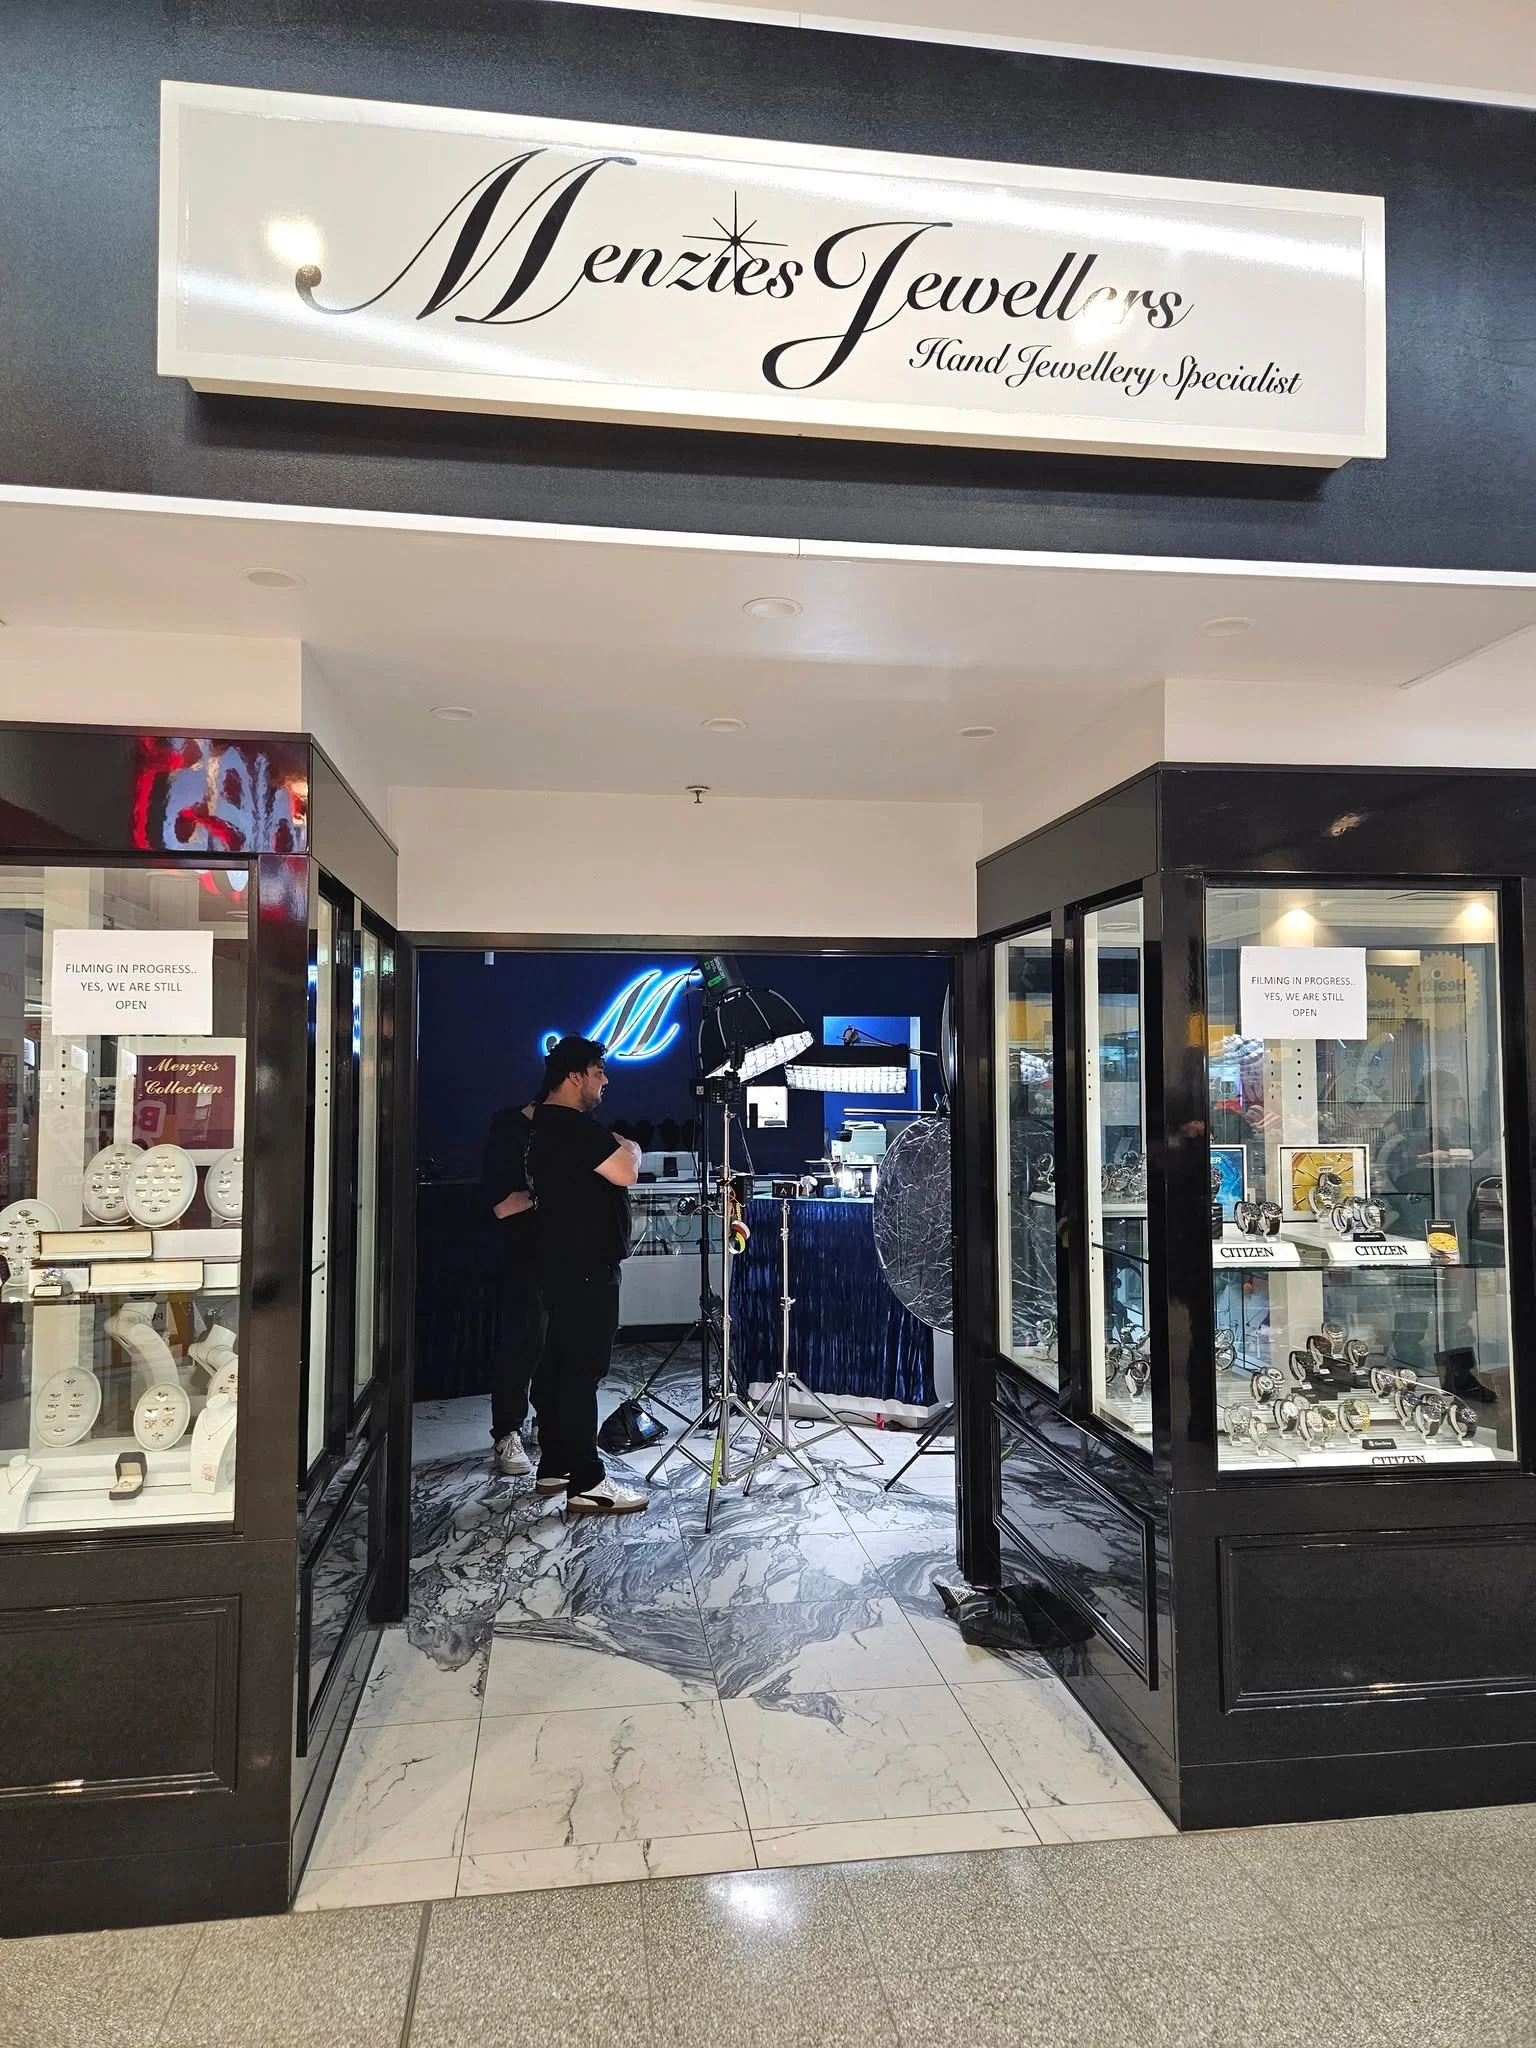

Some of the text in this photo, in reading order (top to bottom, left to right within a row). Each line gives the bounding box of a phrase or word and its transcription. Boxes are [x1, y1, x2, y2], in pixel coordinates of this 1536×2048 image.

[295, 147, 803, 325] Menzies
[908, 337, 1304, 400] Hand Jewellery Specialist
[65, 963, 113, 974] FILMING
[116, 963, 129, 974] IN
[1251, 976, 1290, 986] FILMING
[1292, 976, 1302, 986] IN
[80, 981, 183, 994] YES, WE ARE STILL
[1264, 992, 1344, 1003] YES, WE ARE STILL
[115, 1000, 147, 1010] OPEN
[1292, 1008, 1317, 1017] OPEN
[147, 1057, 219, 1077] Menzies
[144, 1080, 224, 1095] Collection
[1220, 1246, 1275, 1258] CITIZEN
[1354, 1244, 1409, 1256] CITIZEN
